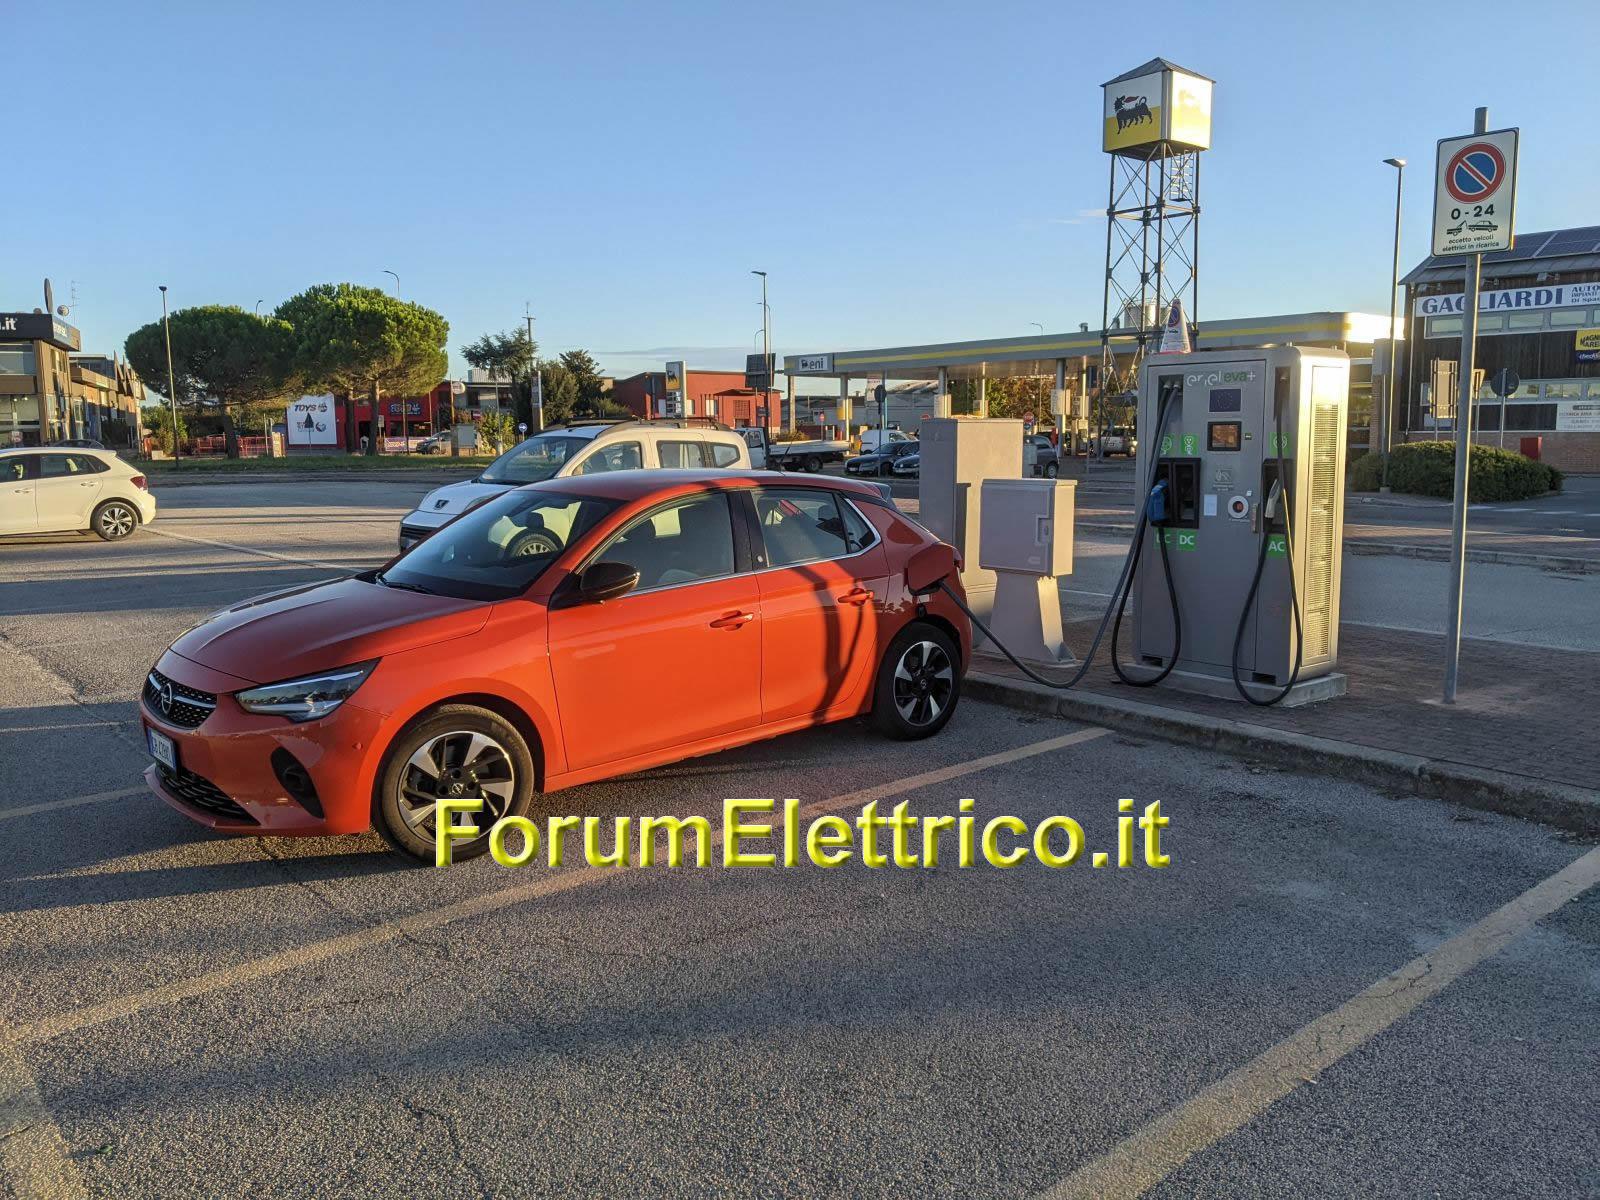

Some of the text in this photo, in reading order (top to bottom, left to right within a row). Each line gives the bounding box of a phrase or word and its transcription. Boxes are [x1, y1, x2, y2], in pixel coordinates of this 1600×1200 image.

[1451, 208, 1461, 220] 0
[1473, 204, 1495, 217] 24
[1473, 234, 1494, 242] veicoli
[1442, 244, 1467, 252] elettrici
[1475, 241, 1500, 249] ricarica
[809, 357, 824, 370] eni
[1186, 370, 1222, 387] enel
[294, 404, 317, 412] TOYS
[1179, 534, 1195, 545] DC
[1268, 540, 1286, 552] AC
